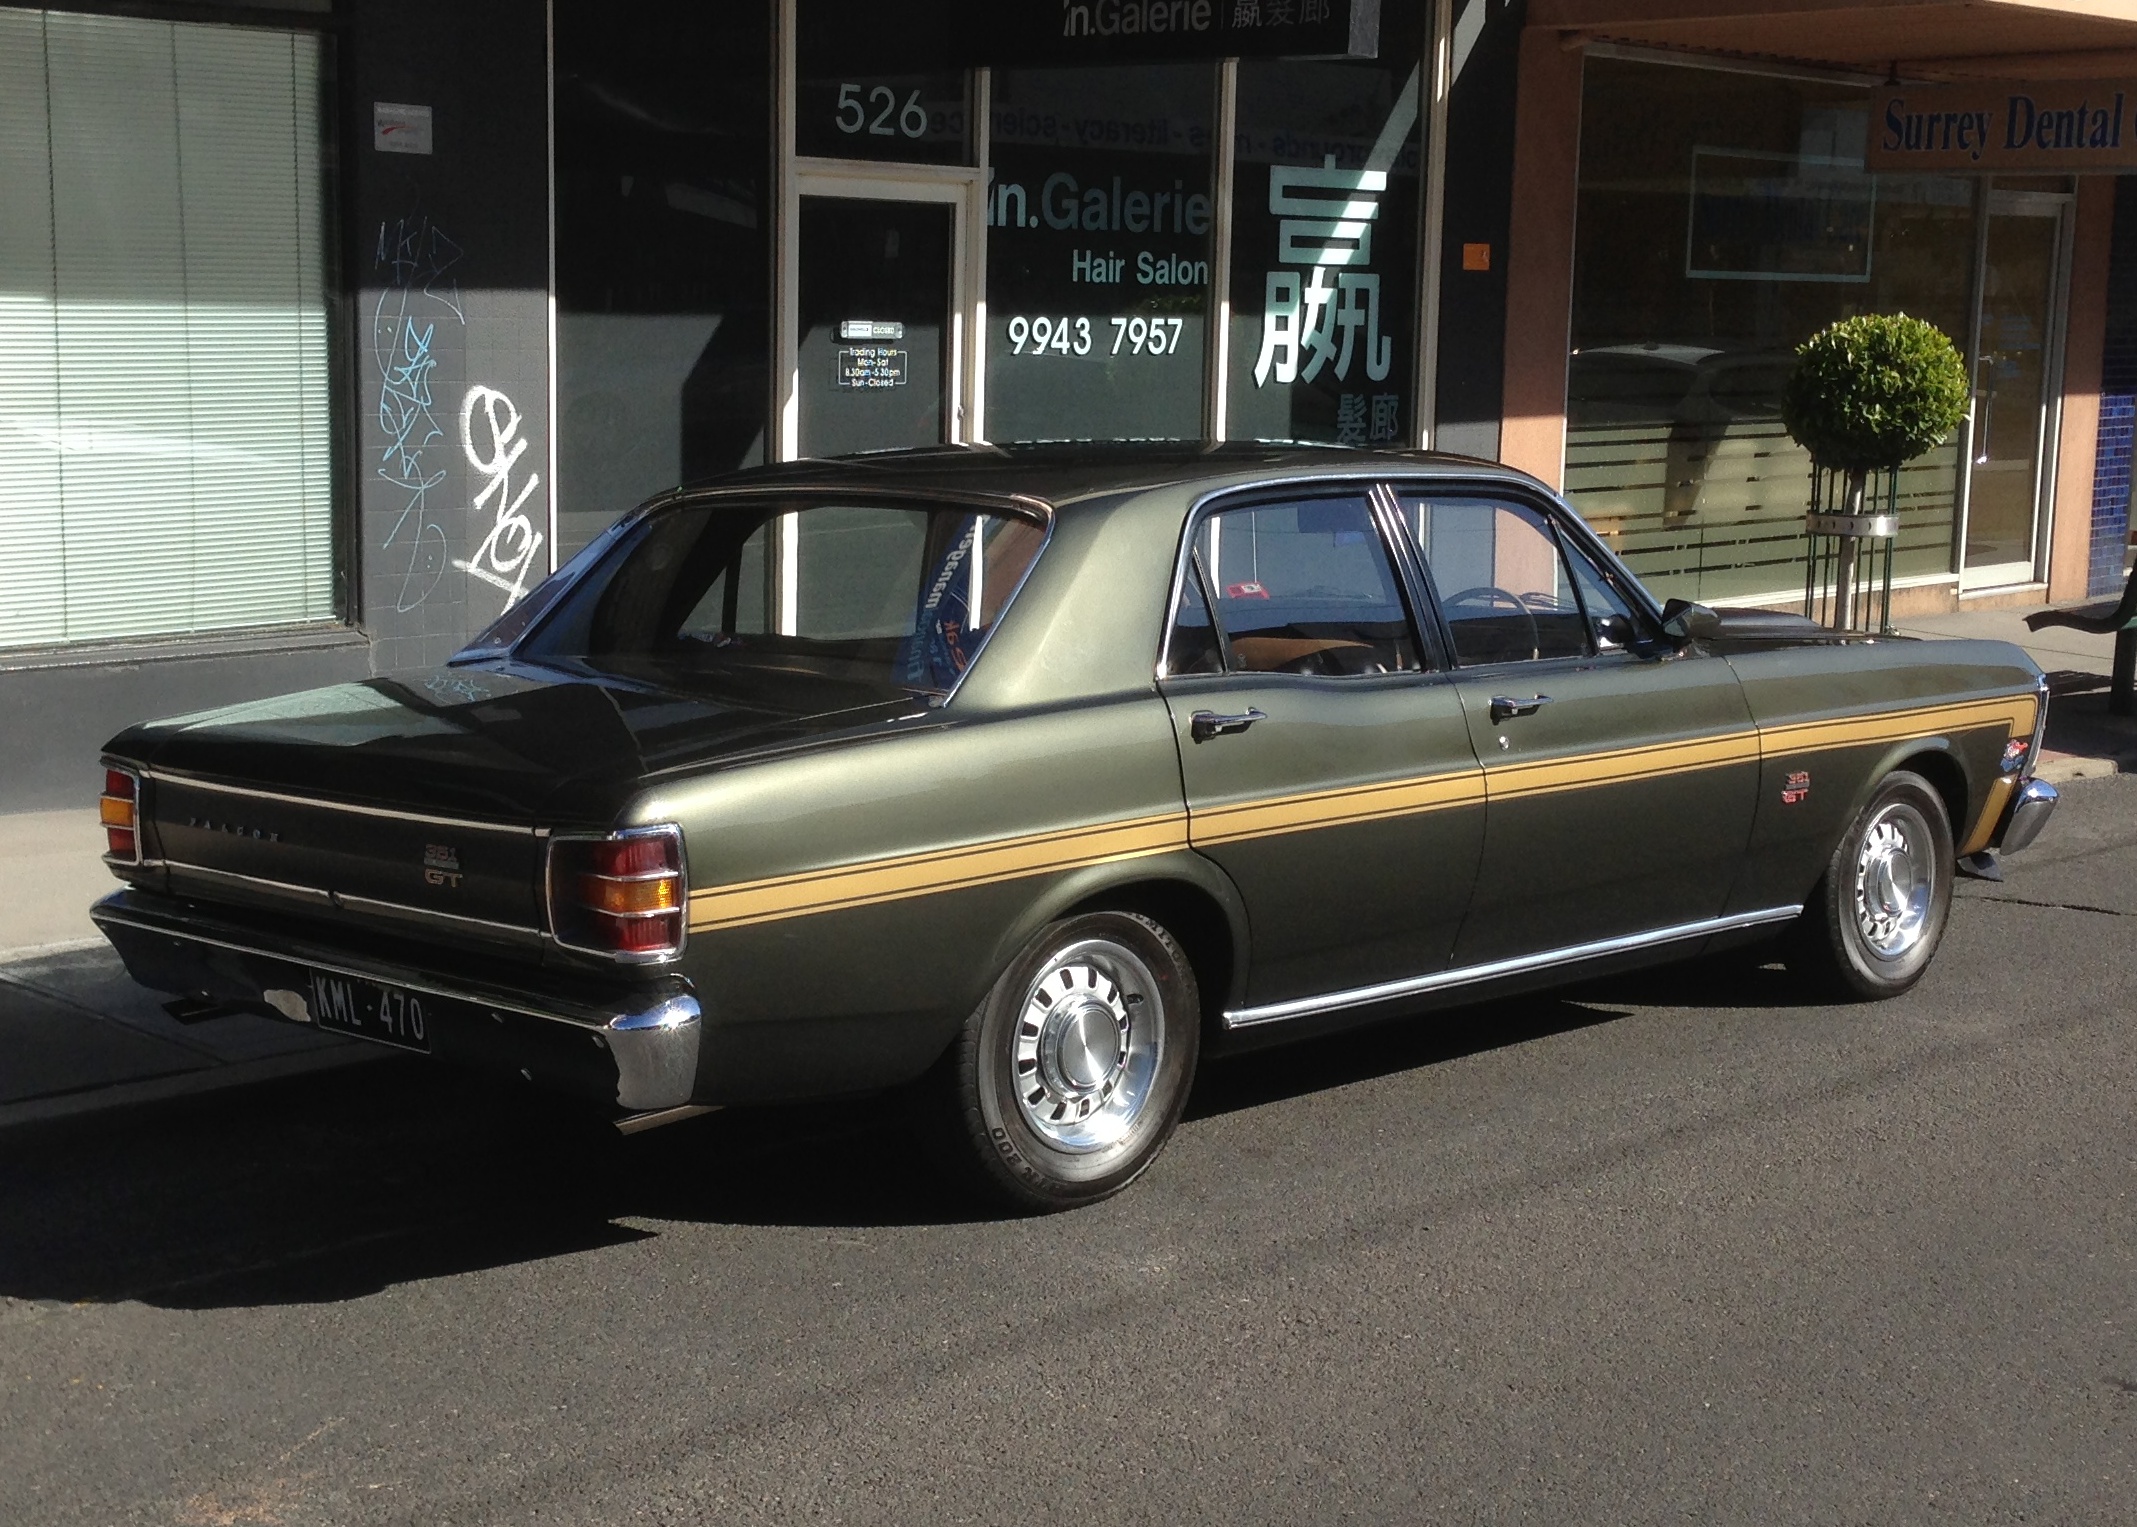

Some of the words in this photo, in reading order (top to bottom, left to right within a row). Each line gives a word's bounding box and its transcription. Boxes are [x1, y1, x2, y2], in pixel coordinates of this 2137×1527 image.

[836, 83, 928, 138] 526
[1883, 97, 1993, 161] Surrey
[2003, 93, 2125, 150] Dental
[1072, 249, 1125, 285] Hair
[1137, 250, 1208, 286] Salon
[849, 347, 875, 358] Trading
[878, 347, 897, 356] Hours
[1008, 316, 1091, 357] 9943
[1111, 317, 1183, 357] 7957
[1781, 788, 1809, 803] GT
[424, 868, 463, 888] GT
[315, 976, 362, 1026] KML
[379, 991, 424, 1041] 470
